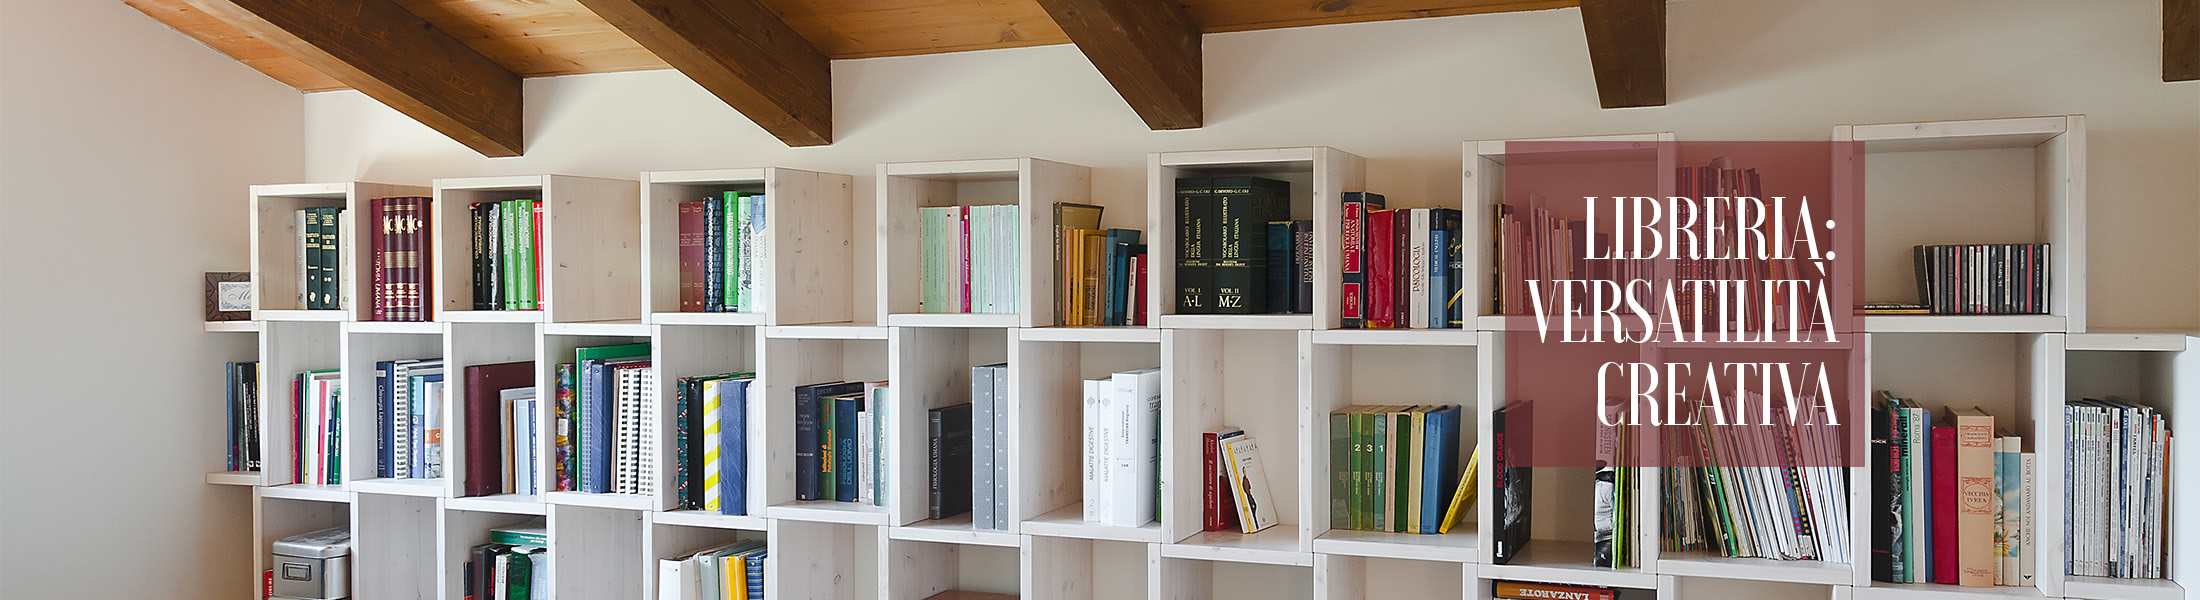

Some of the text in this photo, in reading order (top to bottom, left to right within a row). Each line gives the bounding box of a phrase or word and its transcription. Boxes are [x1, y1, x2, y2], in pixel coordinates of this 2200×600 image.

[1412, 246, 1420, 292] PSICOLOGIA
[377, 384, 385, 450] Chirurgia Laparoscopica
[1603, 413, 1612, 455] SPRNGSTEEN
[1900, 416, 1909, 457] minerali
[1912, 425, 1921, 444] Roma
[1354, 443, 1361, 452] 2
[1366, 443, 1373, 453] 3
[1379, 444, 1384, 453] 1
[1520, 588, 1590, 600] LANZAROTE
